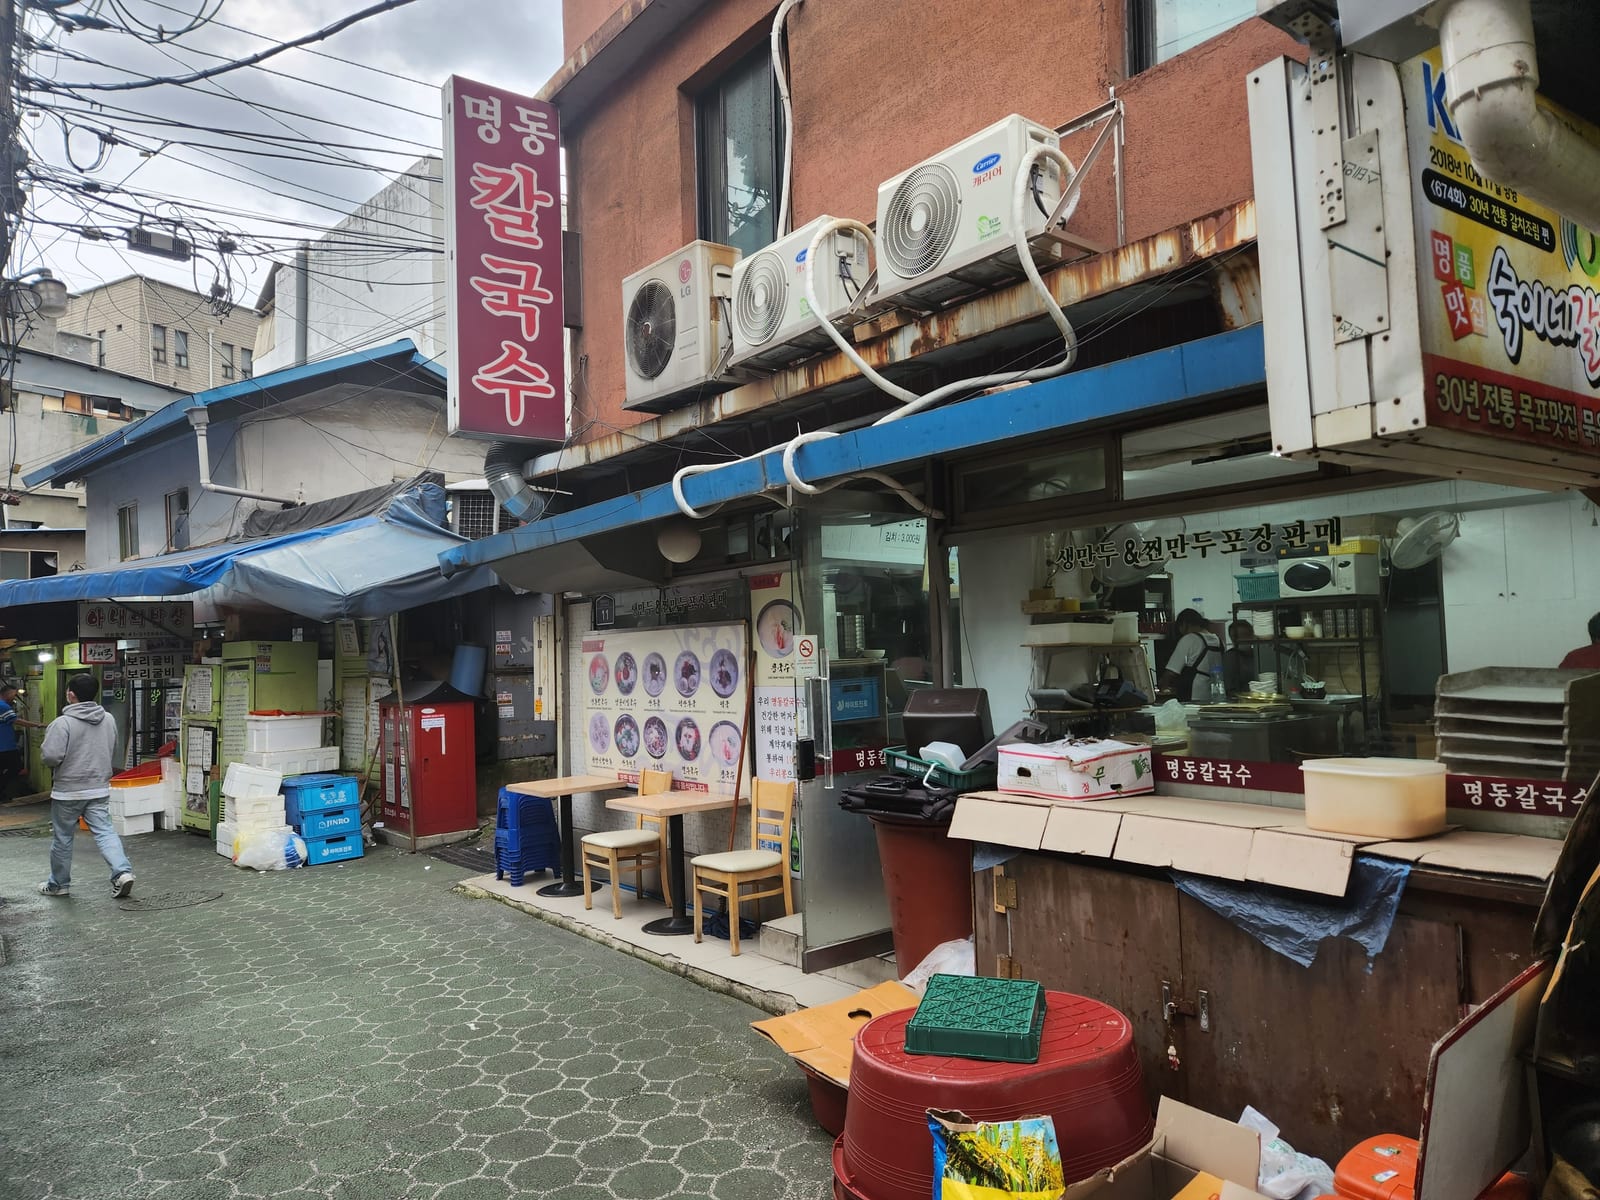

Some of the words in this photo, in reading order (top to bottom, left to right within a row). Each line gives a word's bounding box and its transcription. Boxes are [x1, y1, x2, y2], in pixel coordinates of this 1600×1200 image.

[461, 94, 556, 155] 명동
[976, 156, 999, 171] Carrier
[1430, 146, 1462, 178] 2018년
[973, 166, 1002, 187] 캐리어
[1469, 195, 1490, 219] 30년
[1491, 205, 1508, 228] 전통
[1510, 211, 1540, 240] 갈치조림
[1541, 226, 1550, 246] 편
[1433, 238, 1472, 281] 명품
[469, 162, 556, 427] 칼국수
[681, 286, 691, 298] LG
[1446, 287, 1484, 330] 맛집
[1487, 245, 1600, 389] 숙이네갈
[1436, 374, 1481, 420] 30년
[1482, 385, 1516, 428] 전통
[1519, 394, 1578, 440] 목포맛집
[1582, 408, 1600, 445] 묵
[602, 609, 609, 621] 11
[127, 655, 175, 666] 보리굴비
[127, 667, 175, 679] 보리굴비
[1093, 766, 1105, 786] 무
[1166, 758, 1252, 786] 명동칼국수
[327, 817, 350, 828] JINRO
